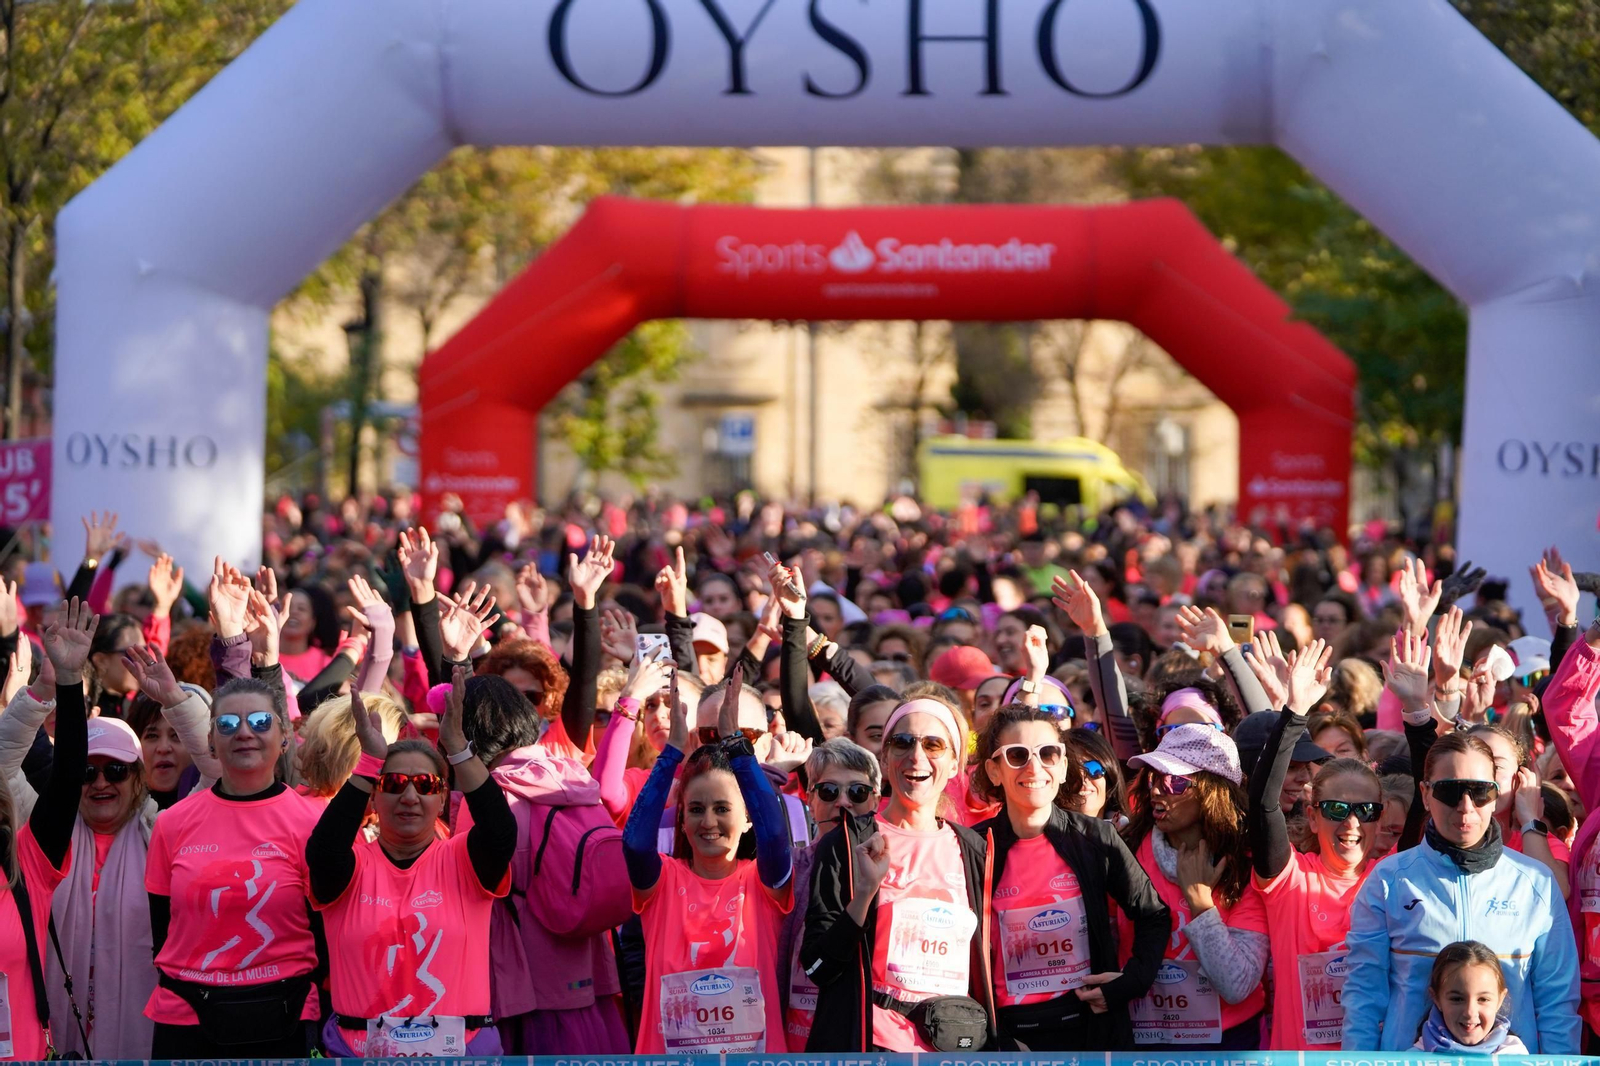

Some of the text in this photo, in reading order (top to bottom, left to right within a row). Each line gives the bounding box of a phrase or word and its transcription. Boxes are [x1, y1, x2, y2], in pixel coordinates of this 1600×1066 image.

[546, 0, 1164, 98] OYSHO
[715, 236, 1057, 279] Sports Santander
[67, 431, 218, 469] OYSHO
[1498, 438, 1600, 477] OYS
[180, 844, 219, 855] OYSHO
[1501, 900, 1516, 910] SG
[1032, 917, 1069, 928] ASTURIANA
[921, 939, 948, 955] 016
[1036, 938, 1073, 955] 016
[1047, 959, 1066, 967] 6899
[216, 972, 229, 983] DE
[231, 973, 244, 982] LA
[246, 965, 280, 980] MUJER
[693, 983, 731, 992] ASTURIANA
[1018, 979, 1049, 990] OYSHO
[1153, 994, 1188, 1008] 016
[696, 1005, 734, 1023] 016
[1163, 1013, 1180, 1021] 2420
[394, 1030, 432, 1039] ASTURIANA
[707, 1027, 726, 1036] 1034
[727, 1046, 757, 1054] Santander
